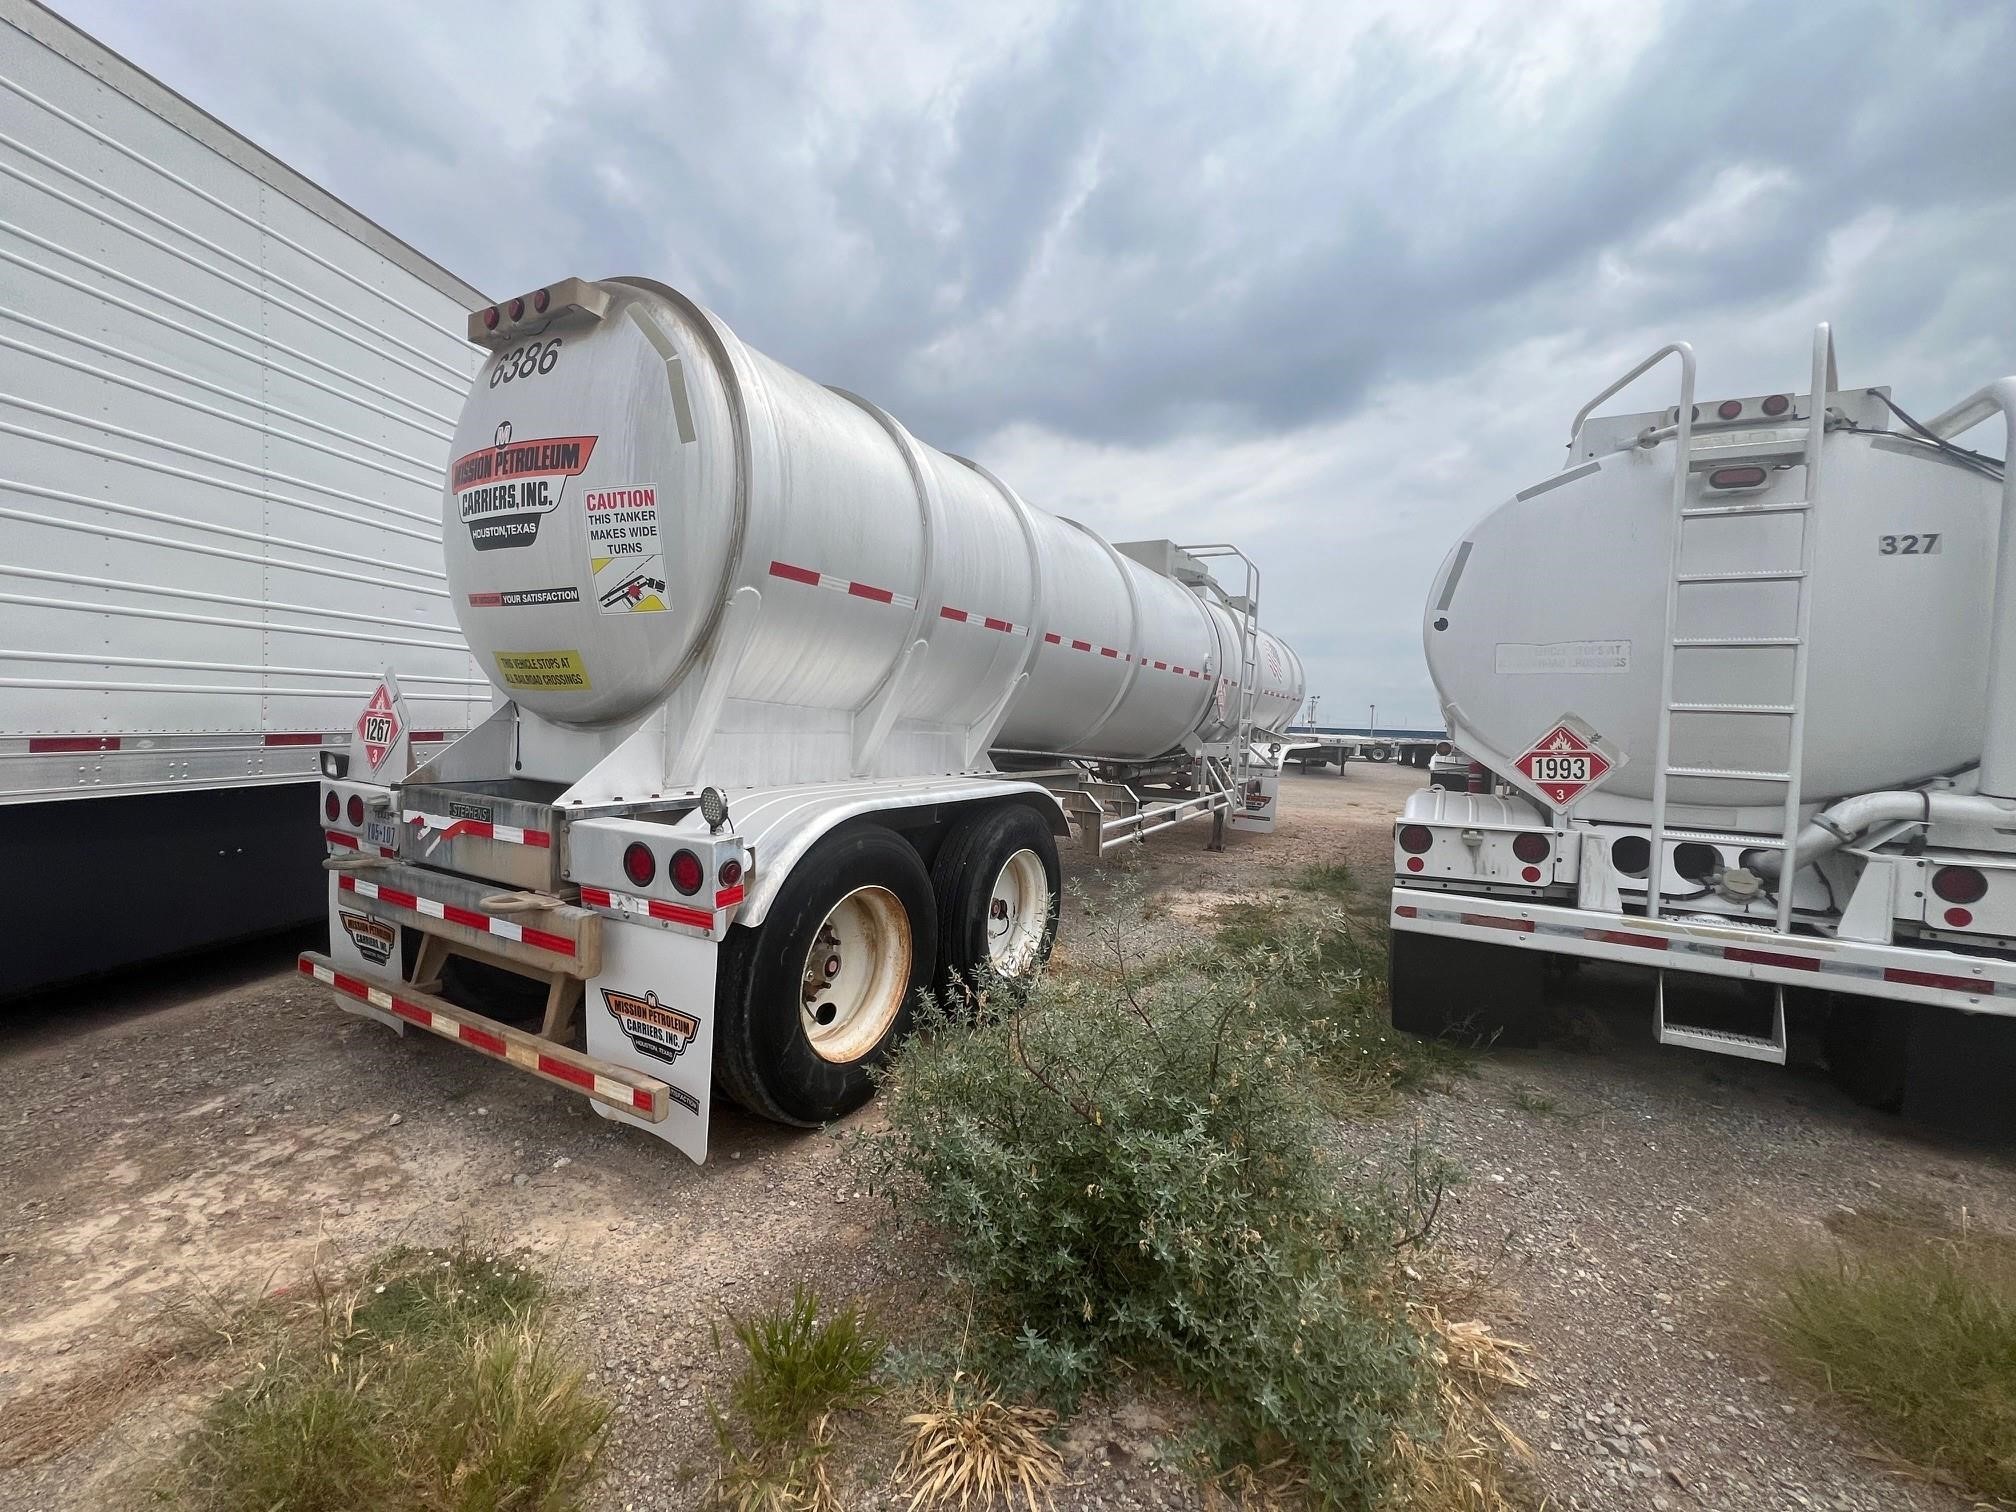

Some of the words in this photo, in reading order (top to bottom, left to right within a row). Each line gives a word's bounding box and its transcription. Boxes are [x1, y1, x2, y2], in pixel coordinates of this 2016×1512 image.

[490, 338, 562, 389] 6386
[454, 454, 493, 488] MISSION
[495, 443, 580, 476] PETROLEUM
[586, 489, 655, 511] CAUTION
[588, 514, 611, 525] THIS
[613, 511, 656, 523] TANKER
[590, 528, 626, 541] MAKES
[629, 526, 657, 537] WIDE
[607, 543, 643, 554] TURNS
[1880, 534, 1941, 555] 327
[502, 594, 521, 604] YOUR
[522, 590, 578, 603] SATISFACTION
[538, 658, 560, 669] STOPS
[561, 657, 570, 668] AT
[543, 673, 583, 685] CROSSINGS
[366, 717, 391, 742] 1267
[372, 750, 378, 763] 3
[1535, 758, 1585, 779] 1993
[1556, 789, 1565, 800] 3
[453, 804, 487, 821] STEPHENS
[614, 999, 647, 1020] MISSION
[648, 1009, 690, 1035] PETROLEUM
[626, 1018, 665, 1043] CARRIERS,
[665, 1032, 680, 1049] INC.
